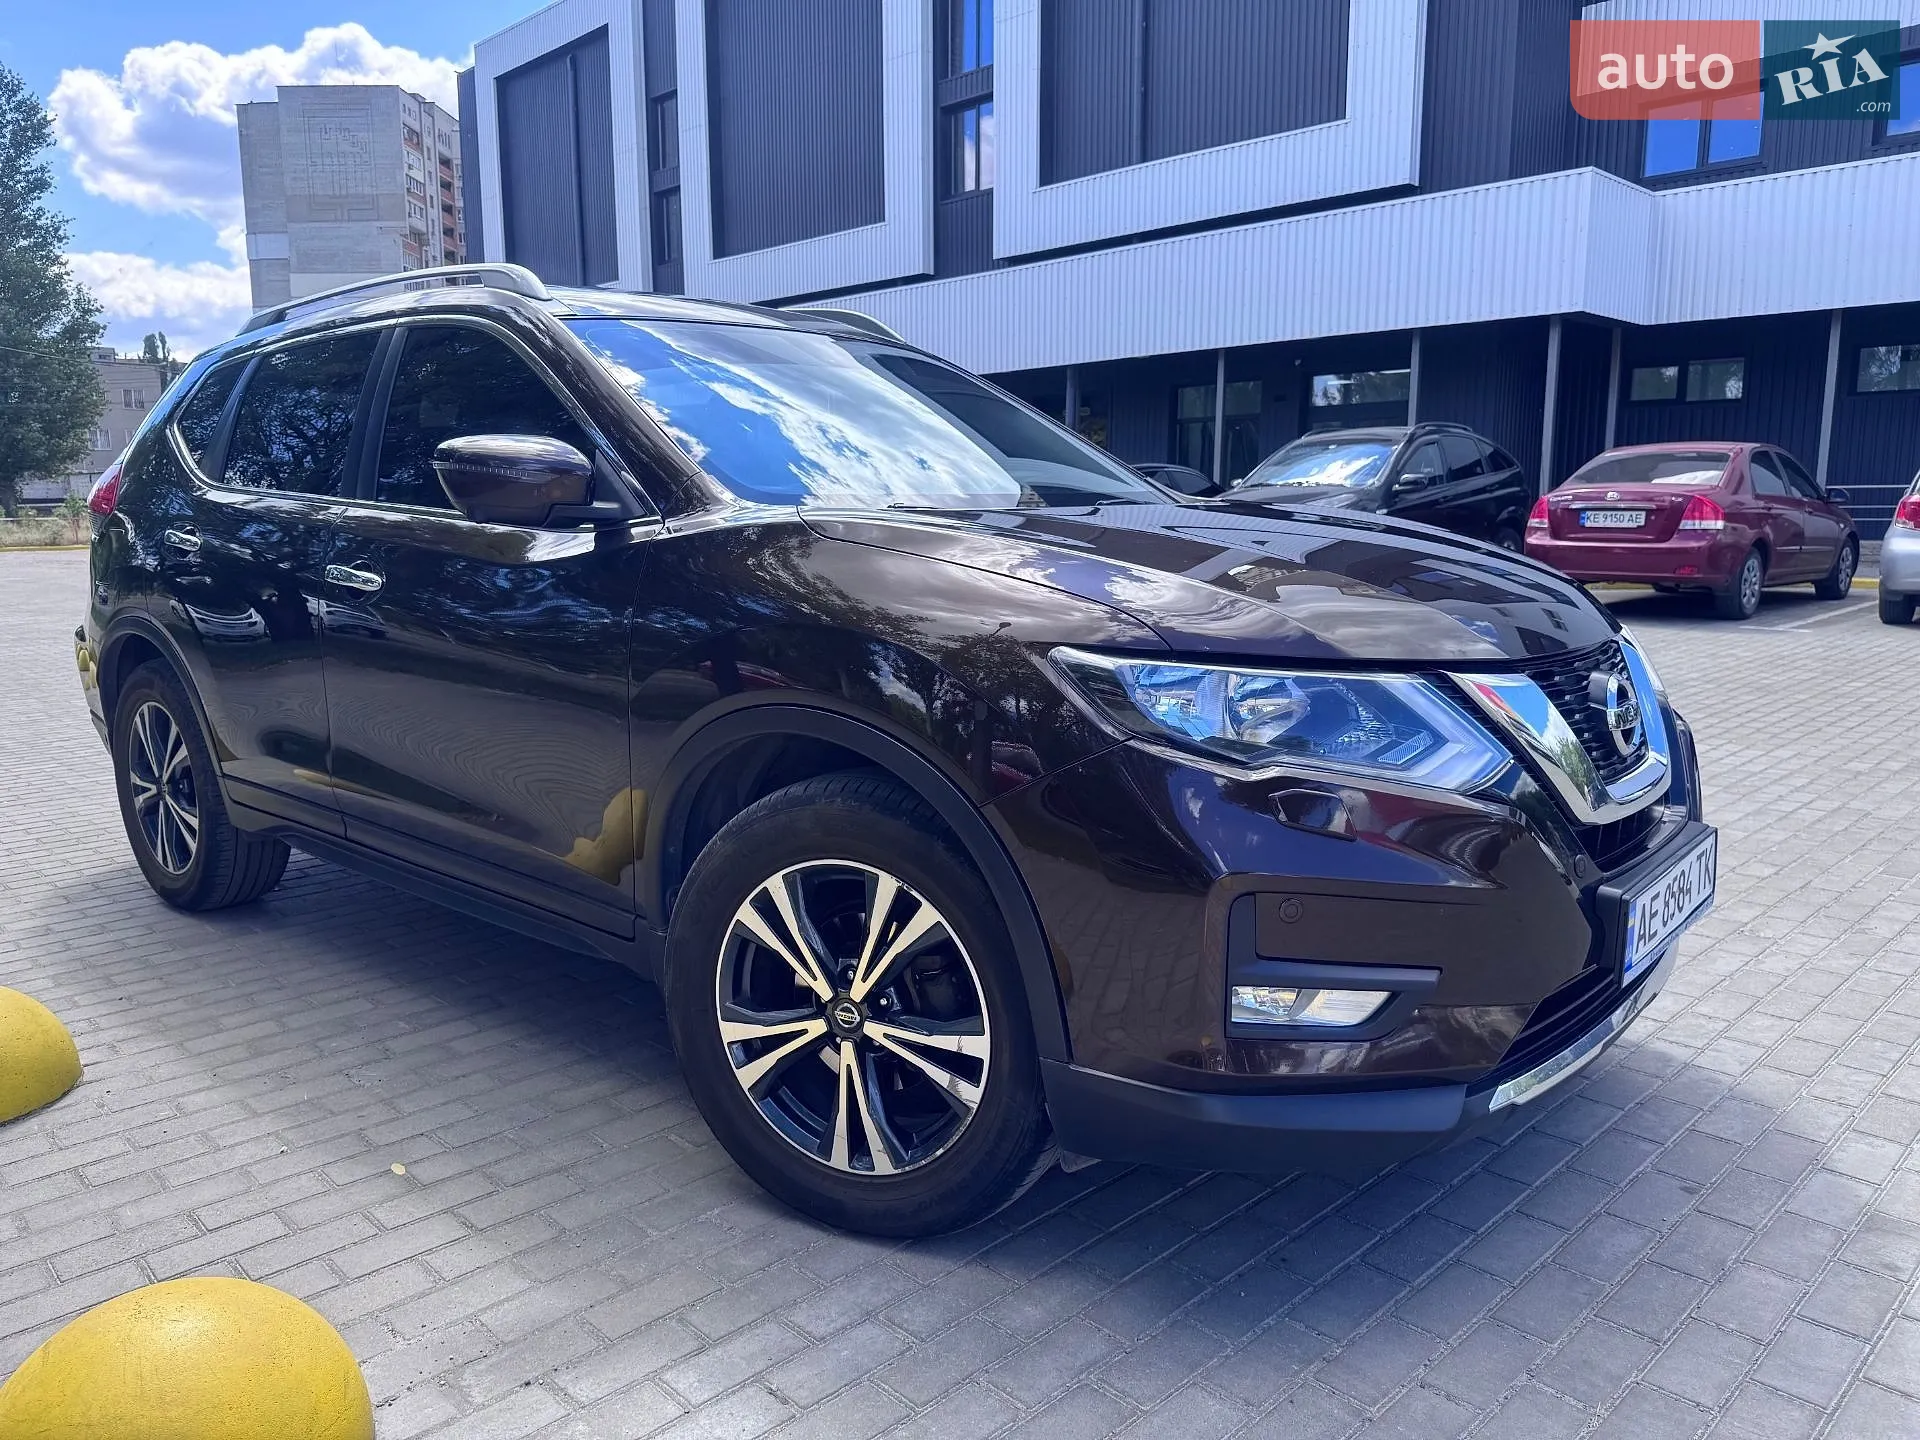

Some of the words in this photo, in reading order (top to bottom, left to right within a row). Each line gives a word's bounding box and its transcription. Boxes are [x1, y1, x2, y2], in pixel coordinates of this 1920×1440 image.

[1586, 512, 1599, 521] KE
[1602, 512, 1625, 521] 9150
[1627, 513, 1642, 521] AE
[1635, 890, 1661, 954] AE
[1662, 861, 1693, 928] 8584
[1696, 843, 1714, 896] TK
